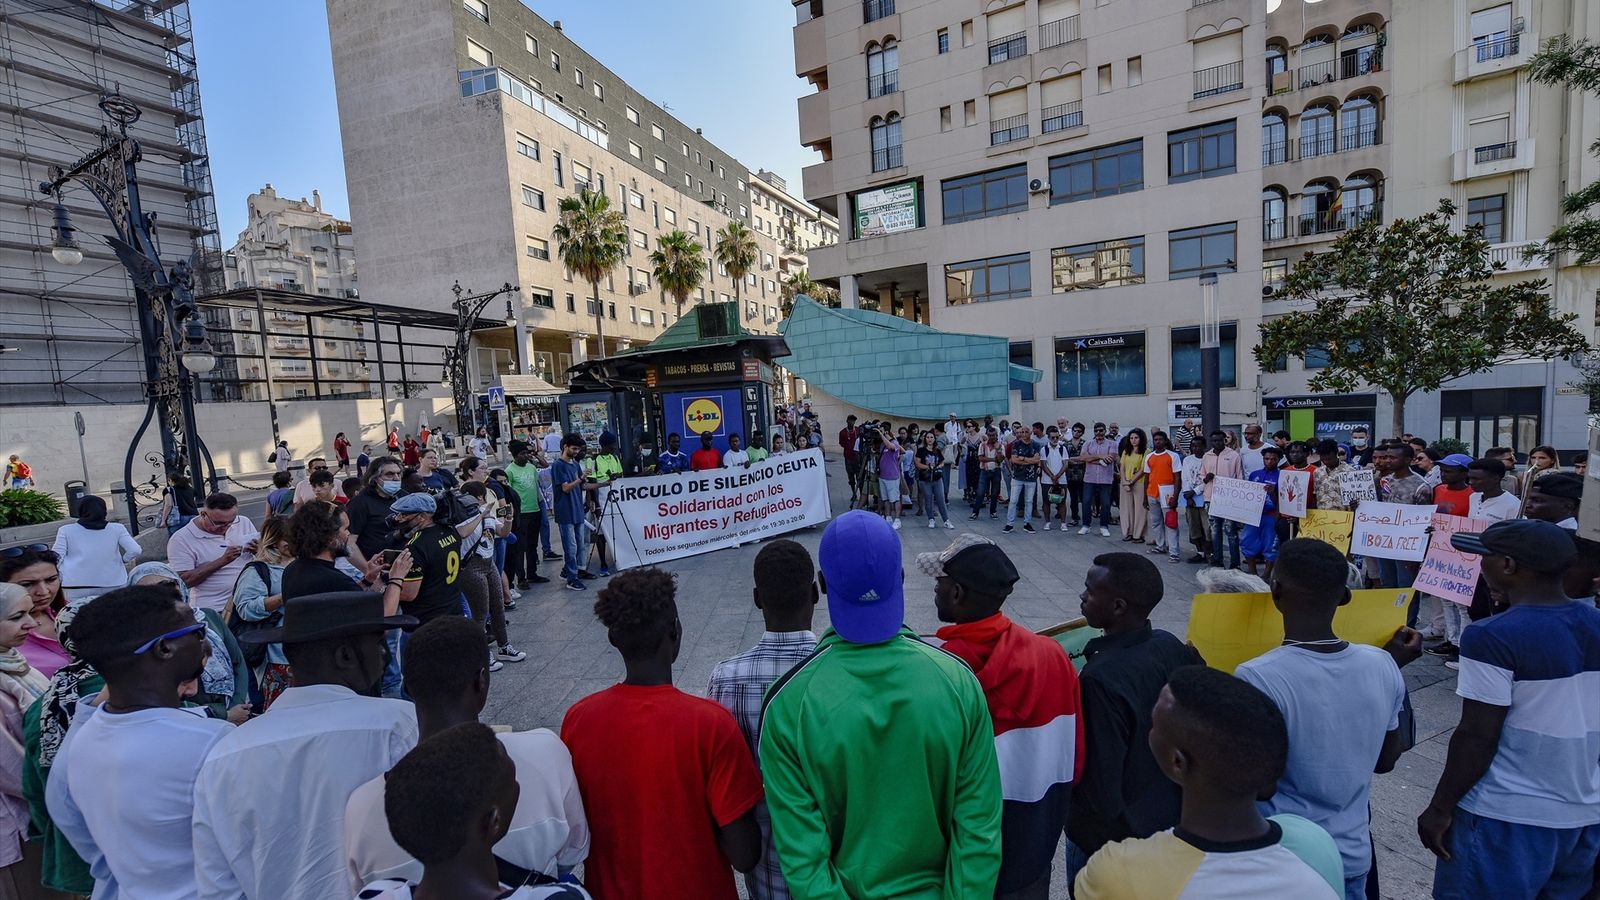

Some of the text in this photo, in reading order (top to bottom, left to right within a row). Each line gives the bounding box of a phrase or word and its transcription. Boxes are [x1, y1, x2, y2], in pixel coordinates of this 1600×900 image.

[882, 212, 914, 223] VENTAS
[1088, 337, 1124, 346] CaixaBank
[665, 365, 687, 375] TABACOS
[691, 363, 709, 373] PRENSA
[713, 362, 736, 371] REVISTAS
[608, 456, 818, 503] CÍRCULO DE SILENCIO CEUTA
[658, 483, 784, 517] Solidaridad con los
[643, 496, 802, 541] Migrantes y Refugiados
[645, 546, 665, 556] Todos
[666, 543, 677, 552] los
[677, 538, 709, 551] segundos
[709, 531, 738, 545] miércoles
[761, 524, 769, 532] de
[769, 519, 785, 529] 19:30
[791, 514, 806, 524] 20:00
[446, 550, 460, 584] 9
